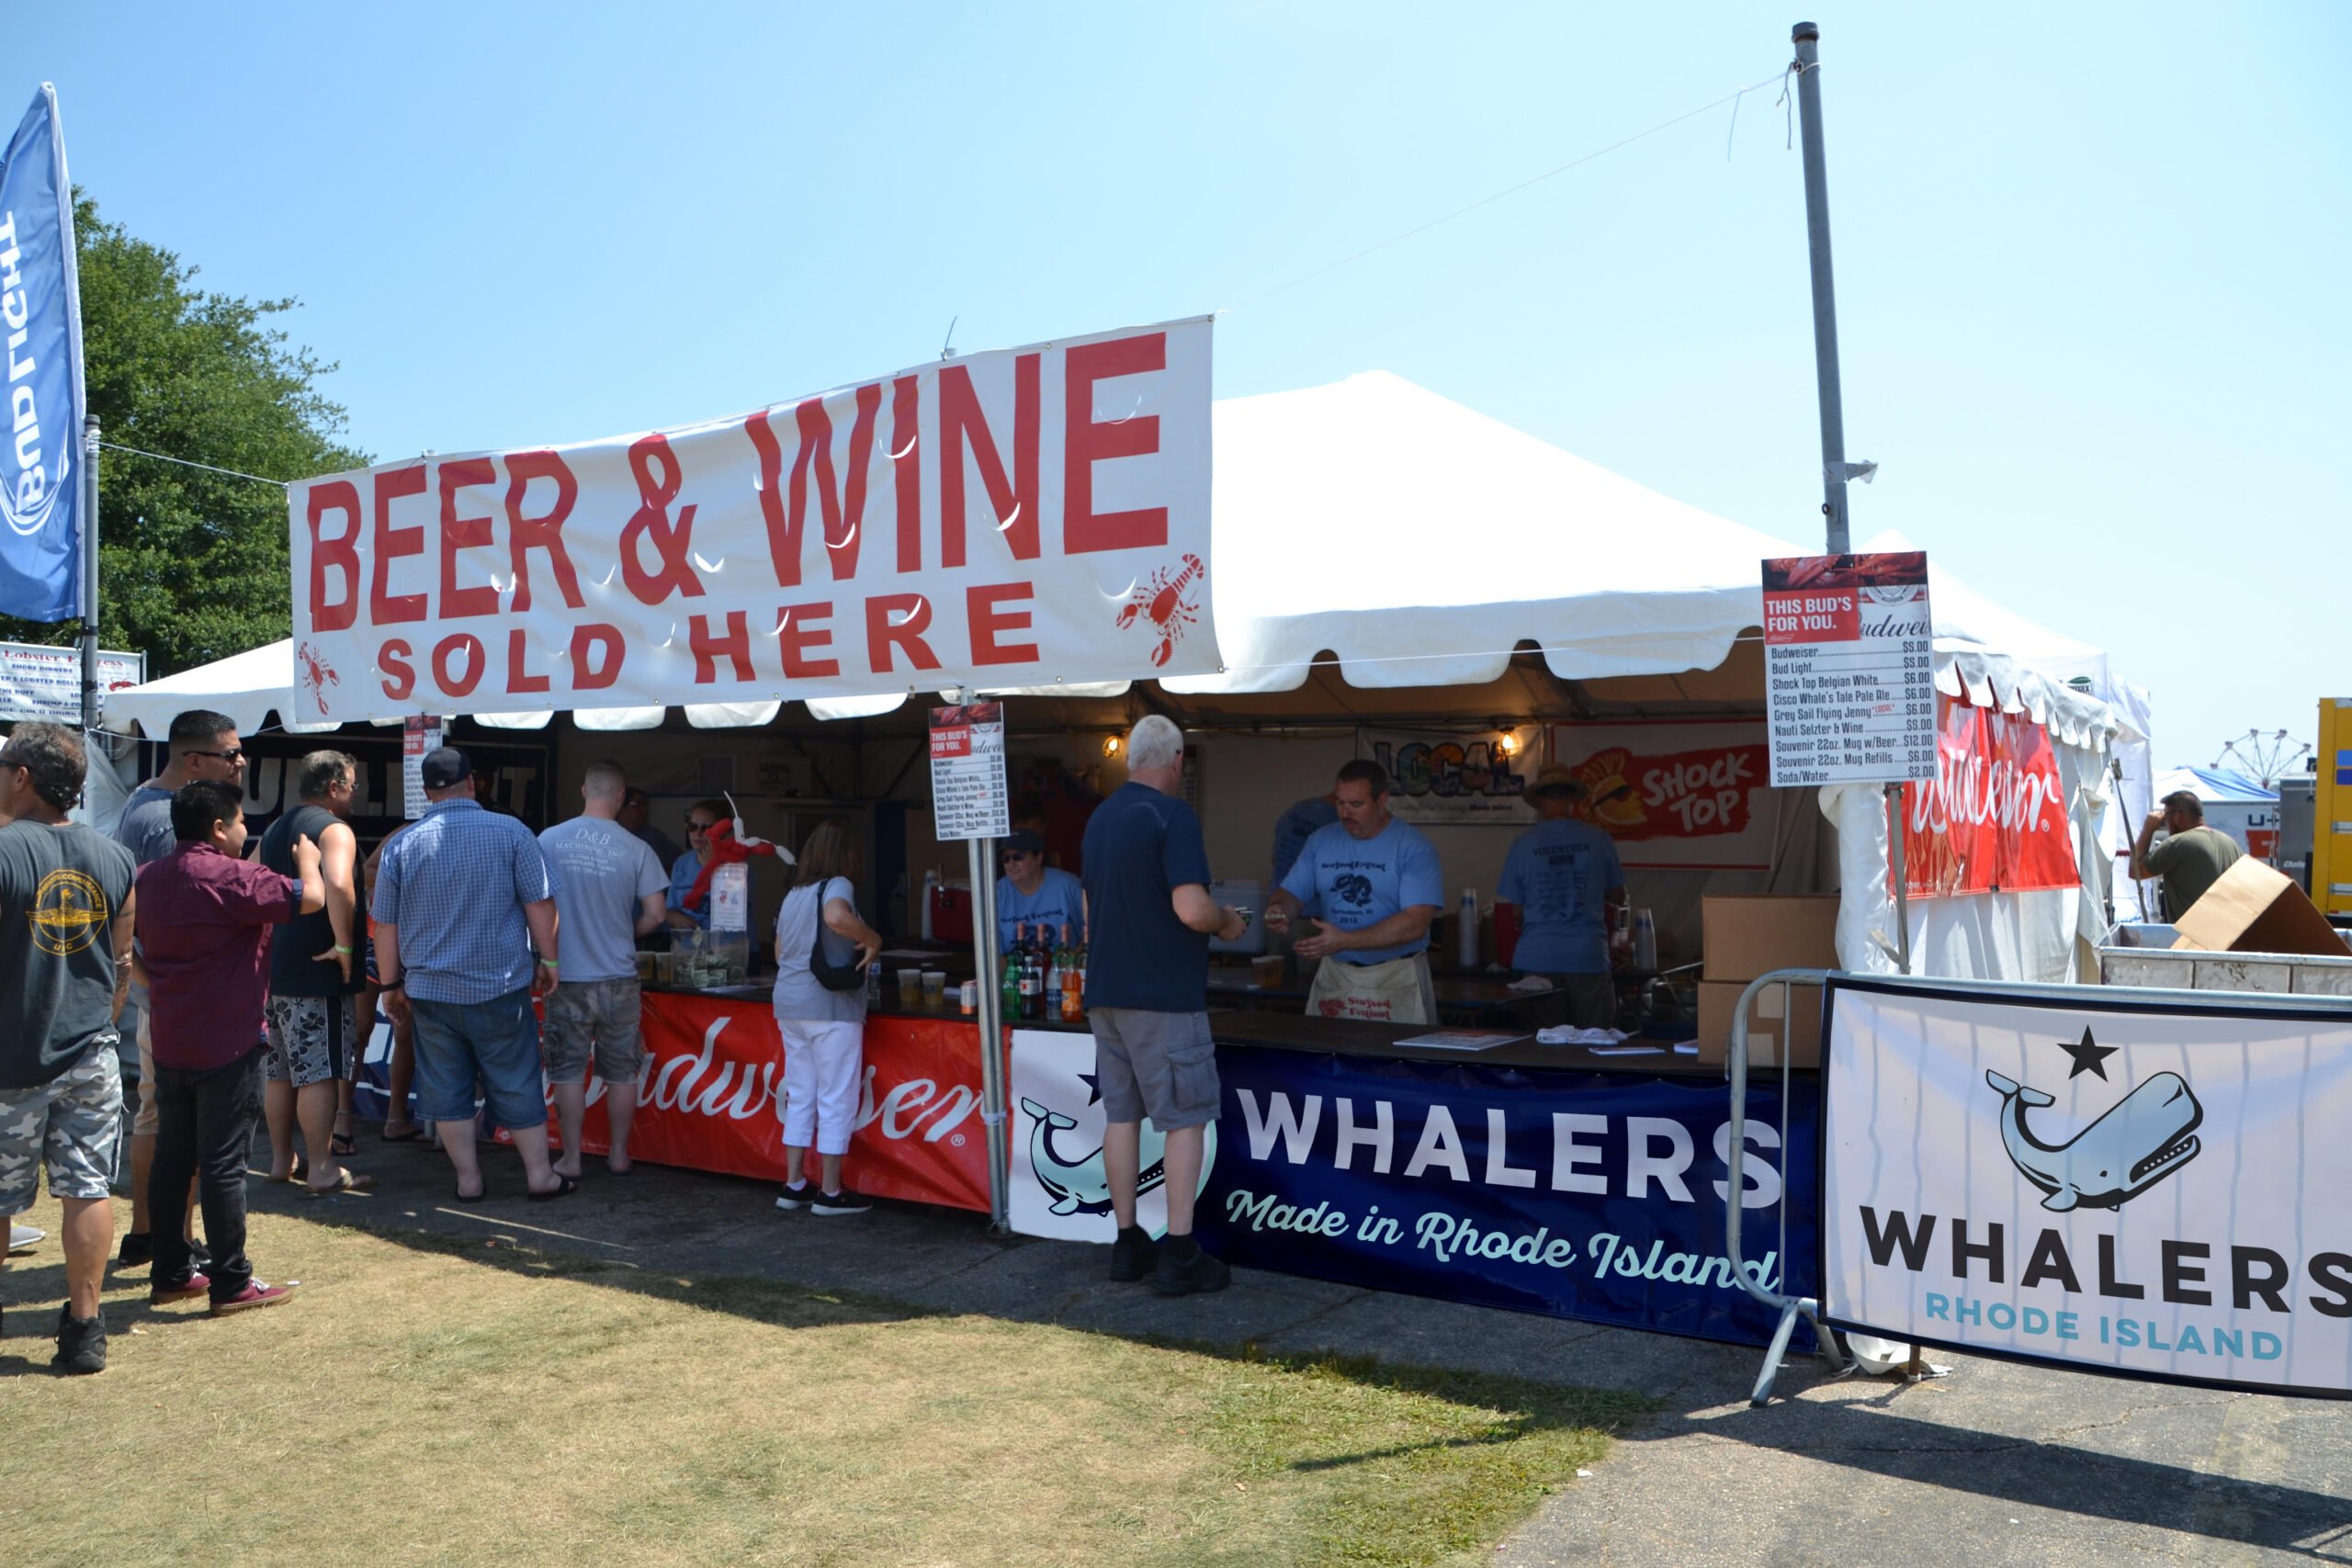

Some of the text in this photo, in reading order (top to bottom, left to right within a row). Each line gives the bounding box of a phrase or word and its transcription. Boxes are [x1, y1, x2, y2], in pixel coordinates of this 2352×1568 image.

[308, 332, 1168, 632] BEER & WINE
[1767, 596, 1852, 615] THIS BUD'S
[1769, 615, 1837, 632] FOR YOU.
[377, 581, 1040, 702] SOLD HERE
[1771, 640, 1928, 660] Budweiser $5.00
[4, 649, 60, 661] Lobster
[1772, 656, 1929, 675] Bud Light $5.00
[1773, 671, 1930, 691] Shock Top Belgian White $6.00
[1773, 687, 1930, 705] Cisco Whale's Tale Pale Ale $6.00
[1774, 709, 1795, 722] Grey
[1798, 708, 1815, 719] Sail
[1816, 707, 1842, 721] Flying
[1845, 706, 1871, 720] Jenny
[1905, 703, 1931, 716] $6.00
[1775, 718, 1932, 737] Nauti Selzter & Wine $5.00
[1776, 734, 1933, 752] Souvenir 22oz. Mug w/Beer $12.00
[1777, 750, 1934, 768] Souvenir 22oz. Mug Refills $6.00
[1374, 741, 1525, 797] LOCAL
[1778, 766, 1934, 784] Soda/Water $2.00
[1643, 752, 1754, 807] SHOCK
[1668, 790, 1740, 832] TOP
[1532, 843, 1590, 857] VOLUNTEER
[1236, 1089, 1782, 1209] WHALERS
[1227, 1190, 1781, 1292] Made in Rhode Island
[1859, 1204, 2352, 1319] WHALERS
[1926, 1292, 2283, 1361] RHODE ISLAND
